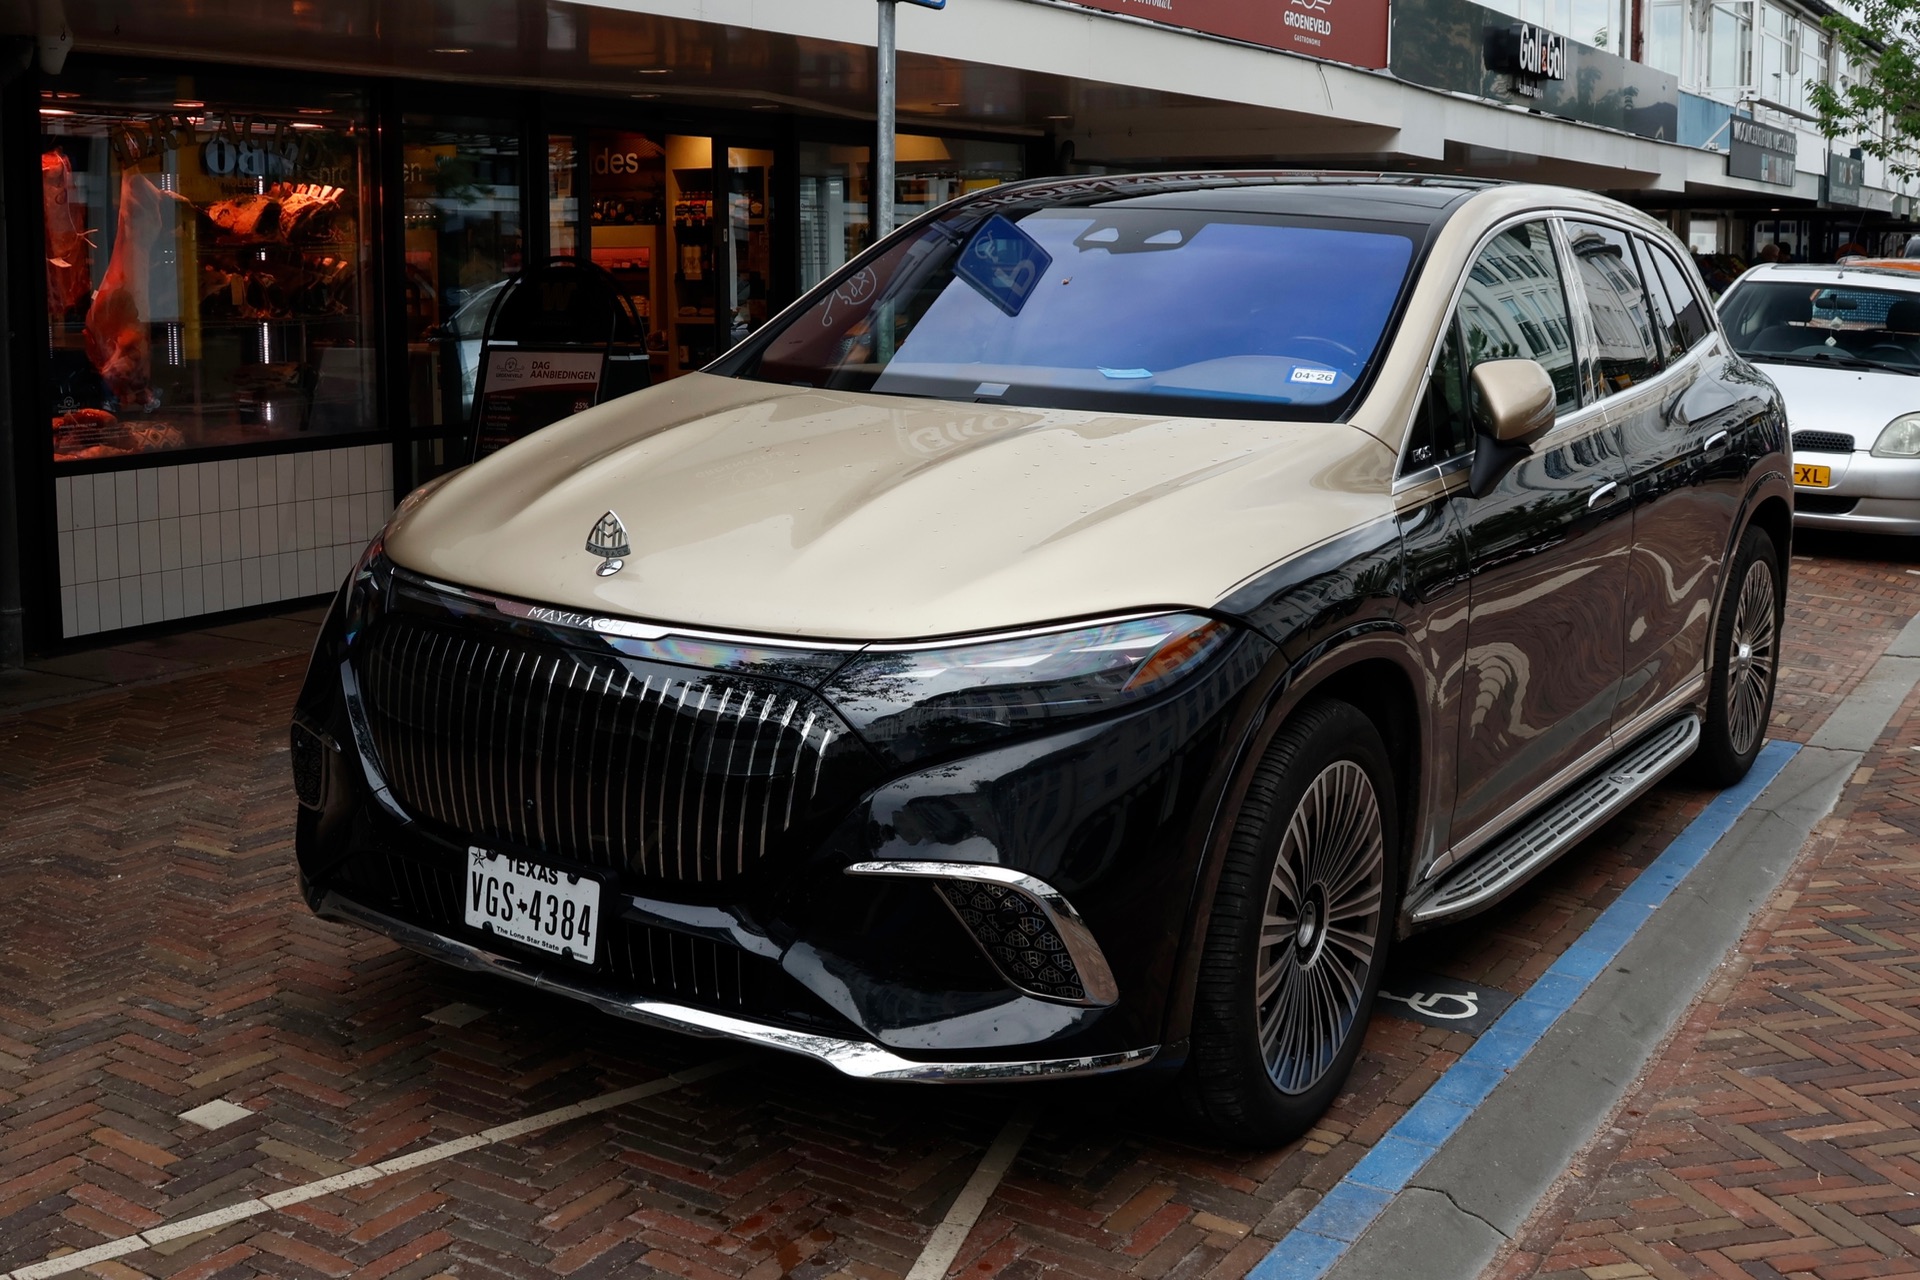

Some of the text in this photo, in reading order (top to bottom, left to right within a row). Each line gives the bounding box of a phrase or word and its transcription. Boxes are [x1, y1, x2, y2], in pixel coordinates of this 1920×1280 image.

[1283, 10, 1332, 36] GROENEVELD
[1293, 34, 1321, 47] GASTRONOMIE
[1519, 23, 1542, 74] Gall
[1547, 32, 1567, 81] Gall
[111, 109, 324, 170] DRY AGED
[530, 370, 596, 380] AANBIEDINGEN
[531, 361, 551, 370] DAG
[574, 401, 589, 410] 25%
[506, 856, 559, 885] TEXAS
[472, 870, 591, 947] VGS 4384
[496, 925, 560, 951] The Lone Star State
